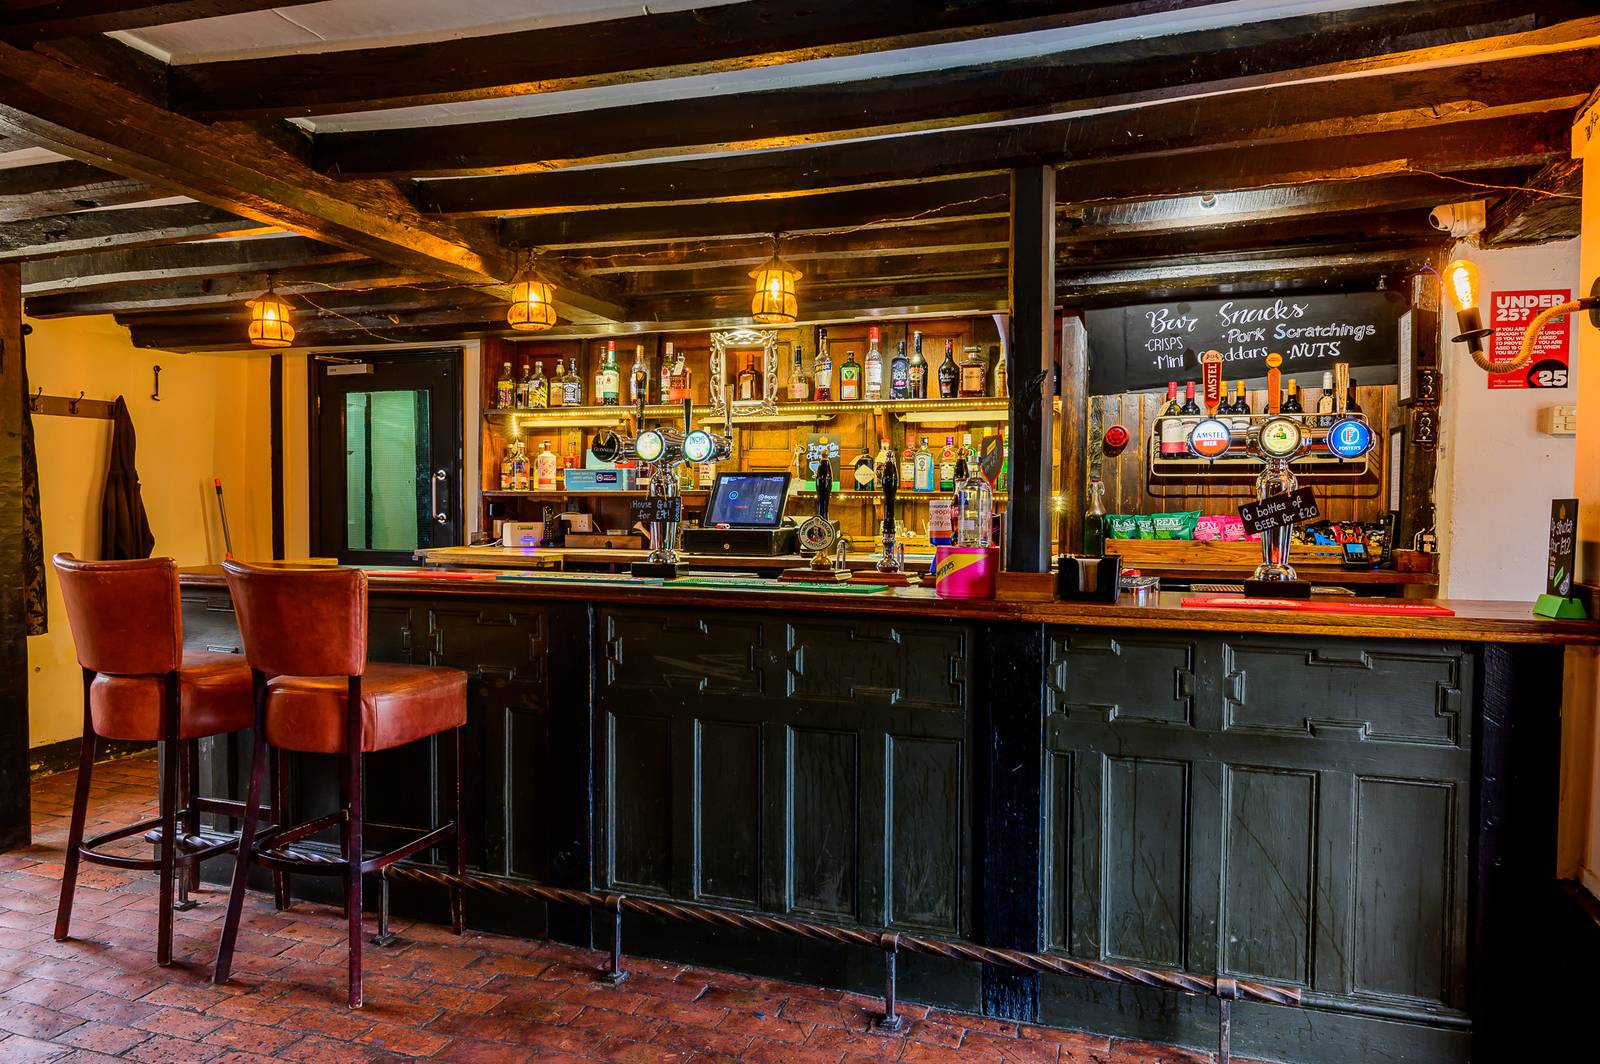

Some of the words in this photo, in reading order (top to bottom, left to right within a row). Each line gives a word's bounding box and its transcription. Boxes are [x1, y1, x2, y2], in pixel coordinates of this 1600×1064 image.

[1495, 294, 1566, 309] UNDER
[1145, 308, 1199, 335] Bar
[1218, 298, 1309, 328] Snacks
[1495, 308, 1531, 322] 25?
[1147, 336, 1184, 352] CRISPS
[1227, 327, 1266, 344] Pork
[1273, 322, 1377, 341] Scratchings
[1157, 354, 1184, 370] Mini
[1197, 345, 1269, 365] Ceddars
[1289, 340, 1341, 360] NUTS
[1207, 363, 1218, 400] AMSTEL
[1538, 369, 1567, 387] 25
[1196, 431, 1225, 439] AMSTEL
[632, 499, 652, 509] House
[1242, 508, 1252, 521] 6
[1256, 501, 1286, 518] bottles
[1292, 495, 1302, 508] of
[637, 509, 651, 520] for
[1254, 517, 1279, 531] BEER
[1281, 512, 1296, 524] for
[1299, 505, 1317, 519] £20
[1225, 523, 1243, 532] EAL
